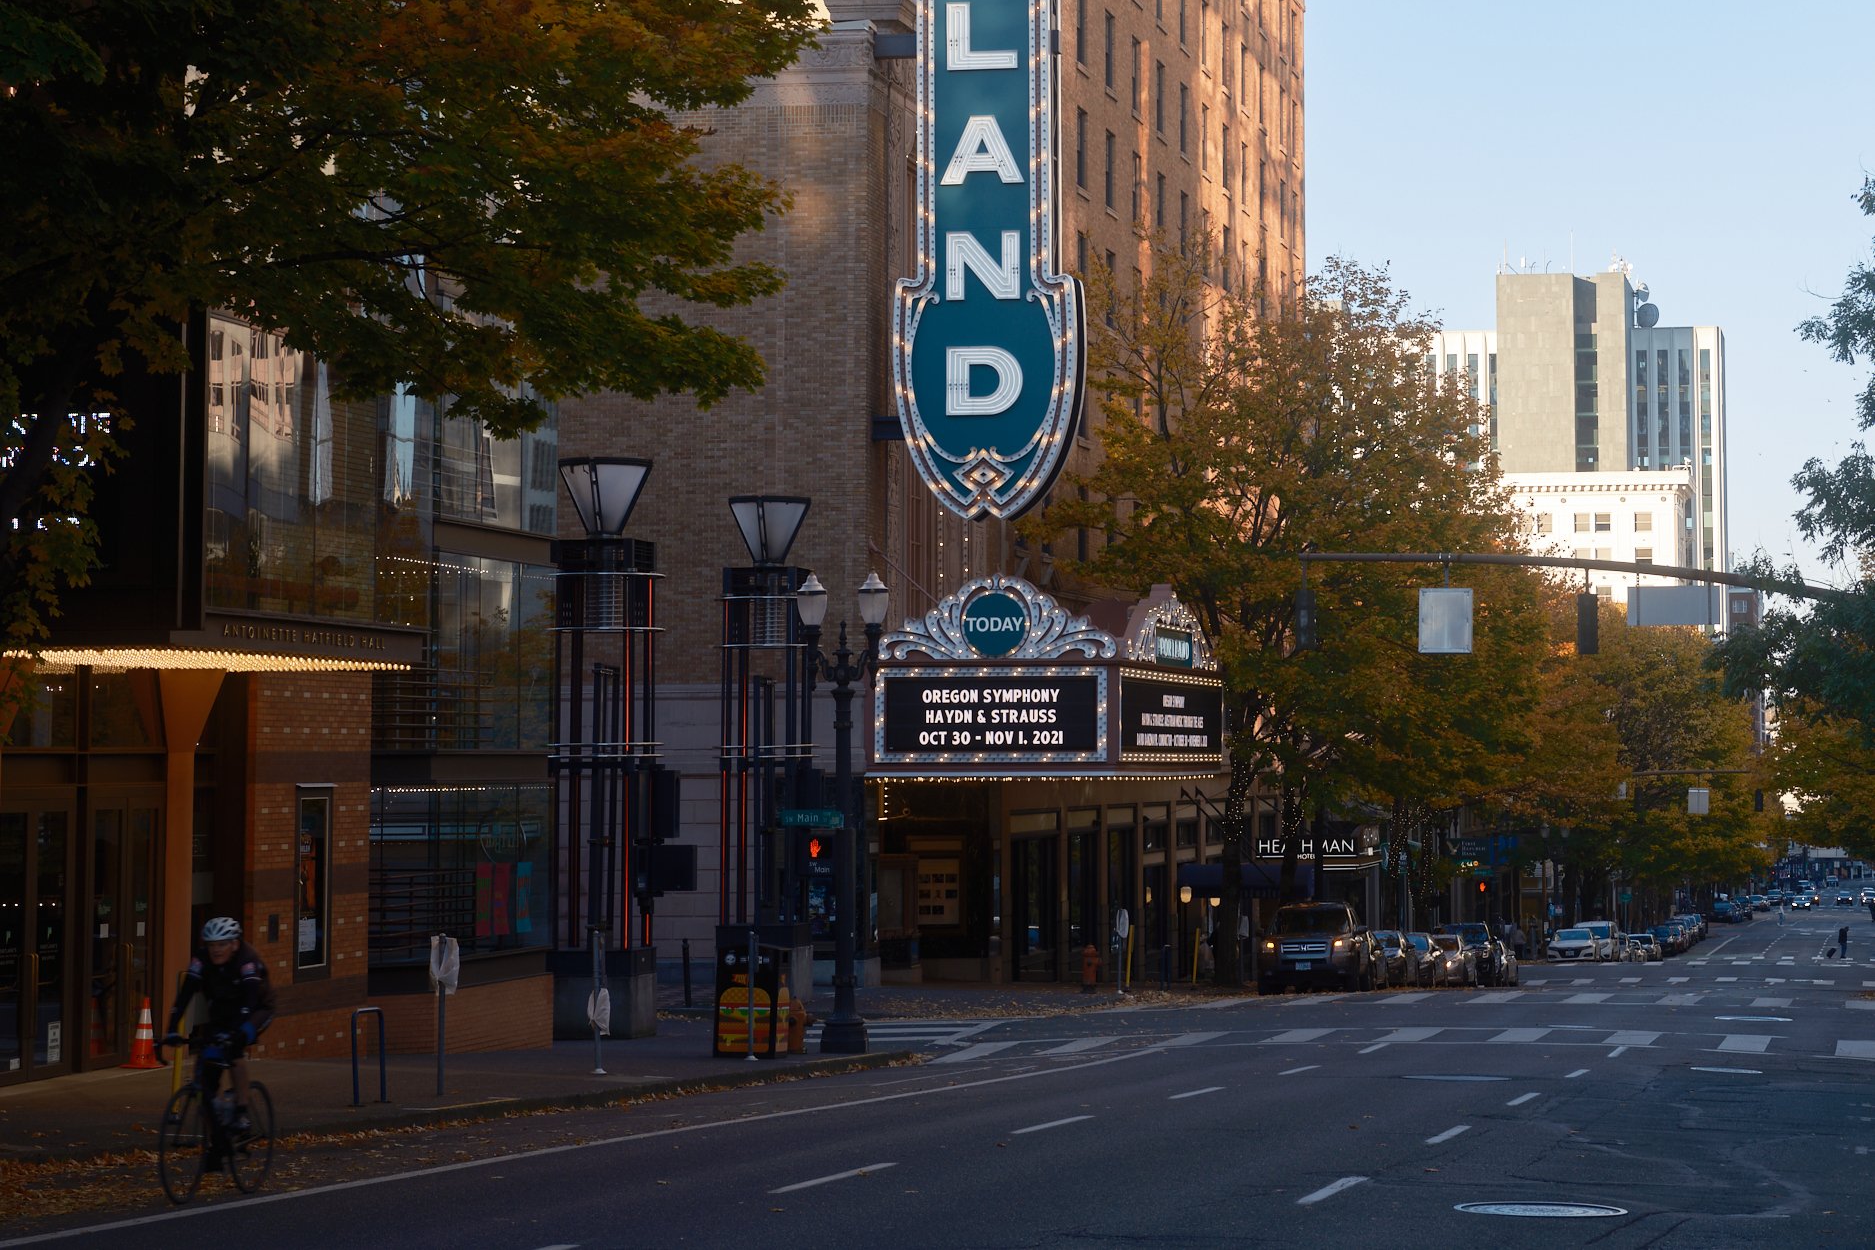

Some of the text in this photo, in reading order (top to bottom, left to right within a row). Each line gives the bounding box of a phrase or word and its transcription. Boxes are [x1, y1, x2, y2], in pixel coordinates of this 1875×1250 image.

[966, 617, 1023, 632] TODAY
[223, 623, 386, 649] ANTOINETTE HATFIELD HALL
[922, 689, 1060, 704] OREGON SYMPHONY
[925, 709, 1057, 724] HAYDN & STRAUSS
[918, 731, 948, 746] OCT
[951, 731, 971, 746] 30
[985, 731, 1014, 745] NOV
[1032, 730, 1064, 745] 2021
[797, 813, 819, 823] Main
[814, 866, 830, 874] Main
